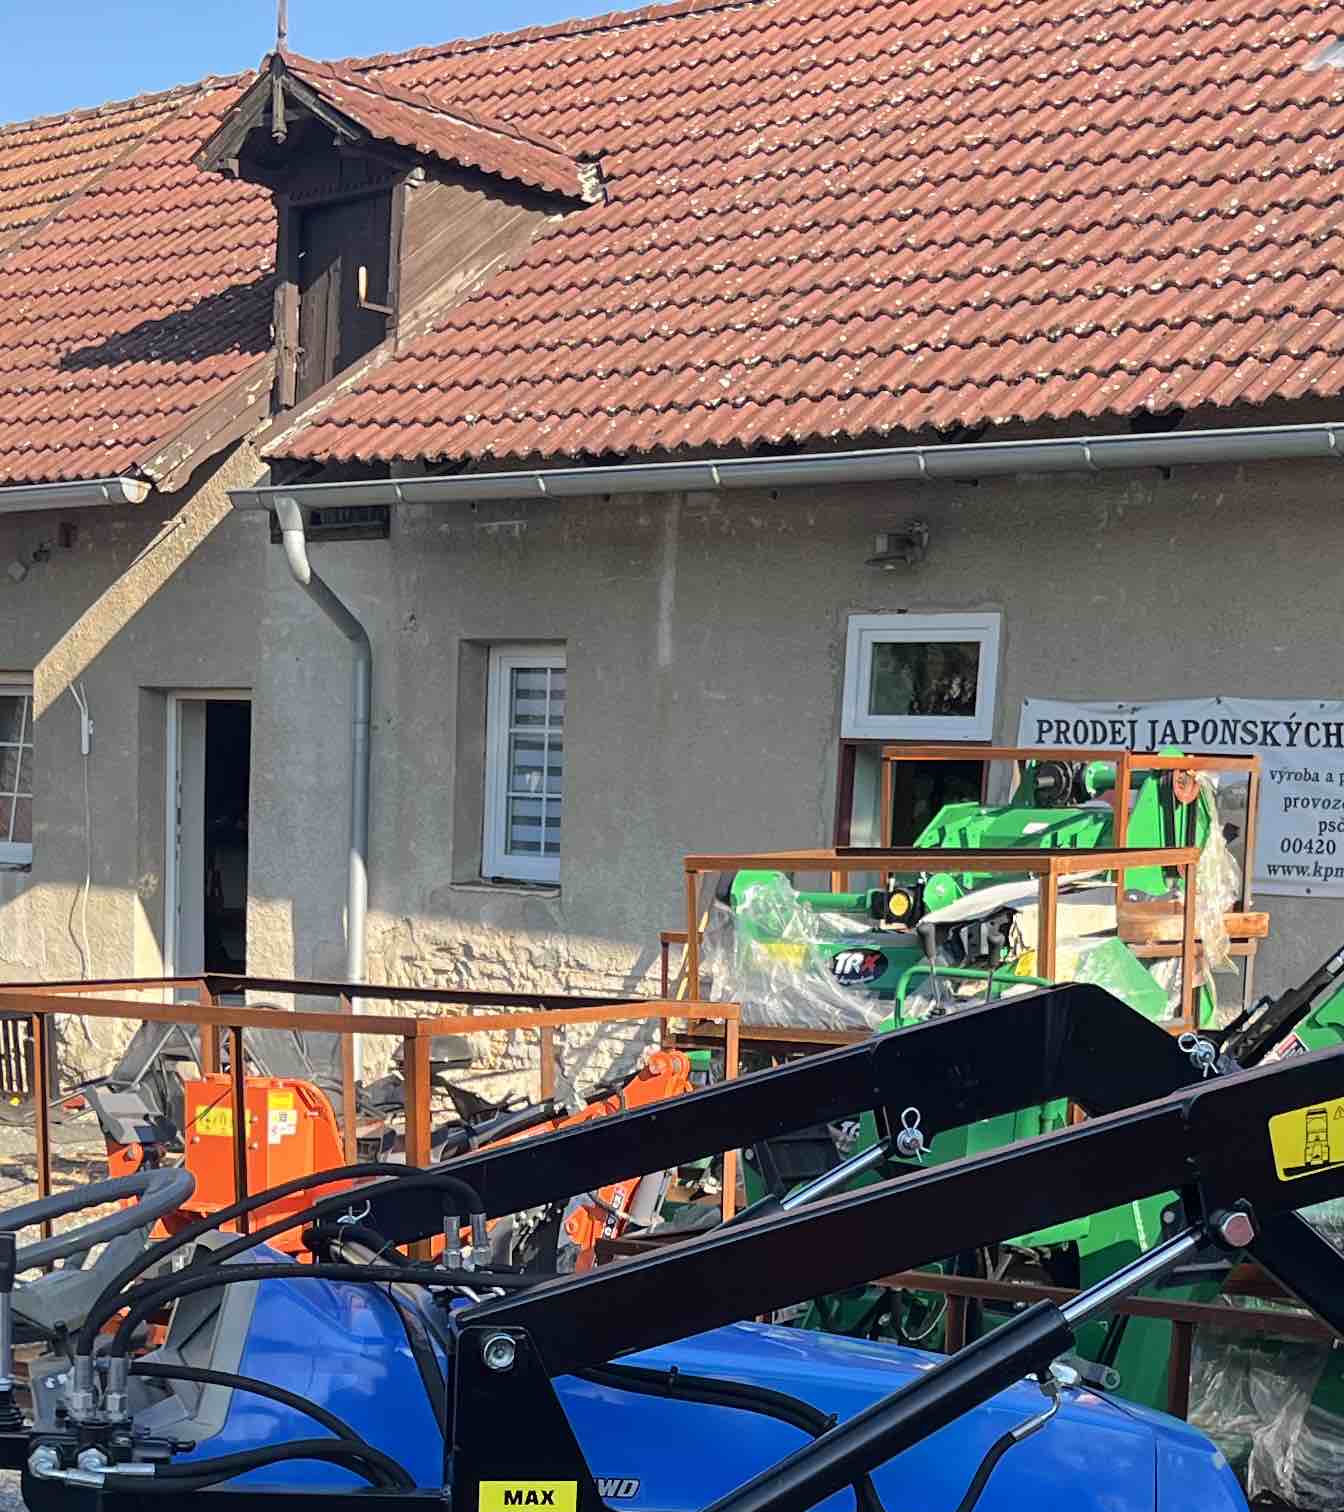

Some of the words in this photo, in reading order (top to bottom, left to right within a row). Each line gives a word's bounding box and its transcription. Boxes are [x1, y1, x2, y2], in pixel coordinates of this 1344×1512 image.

[1034, 718, 1138, 751] PRODEJ
[1145, 712, 1344, 751] JAPONSKÝCH
[1269, 768, 1320, 784] výroba
[1325, 772, 1336, 783] a
[1280, 837, 1337, 855] 00420
[835, 951, 880, 975] TRX
[593, 1478, 639, 1497] WD
[503, 1489, 555, 1506] MAX
